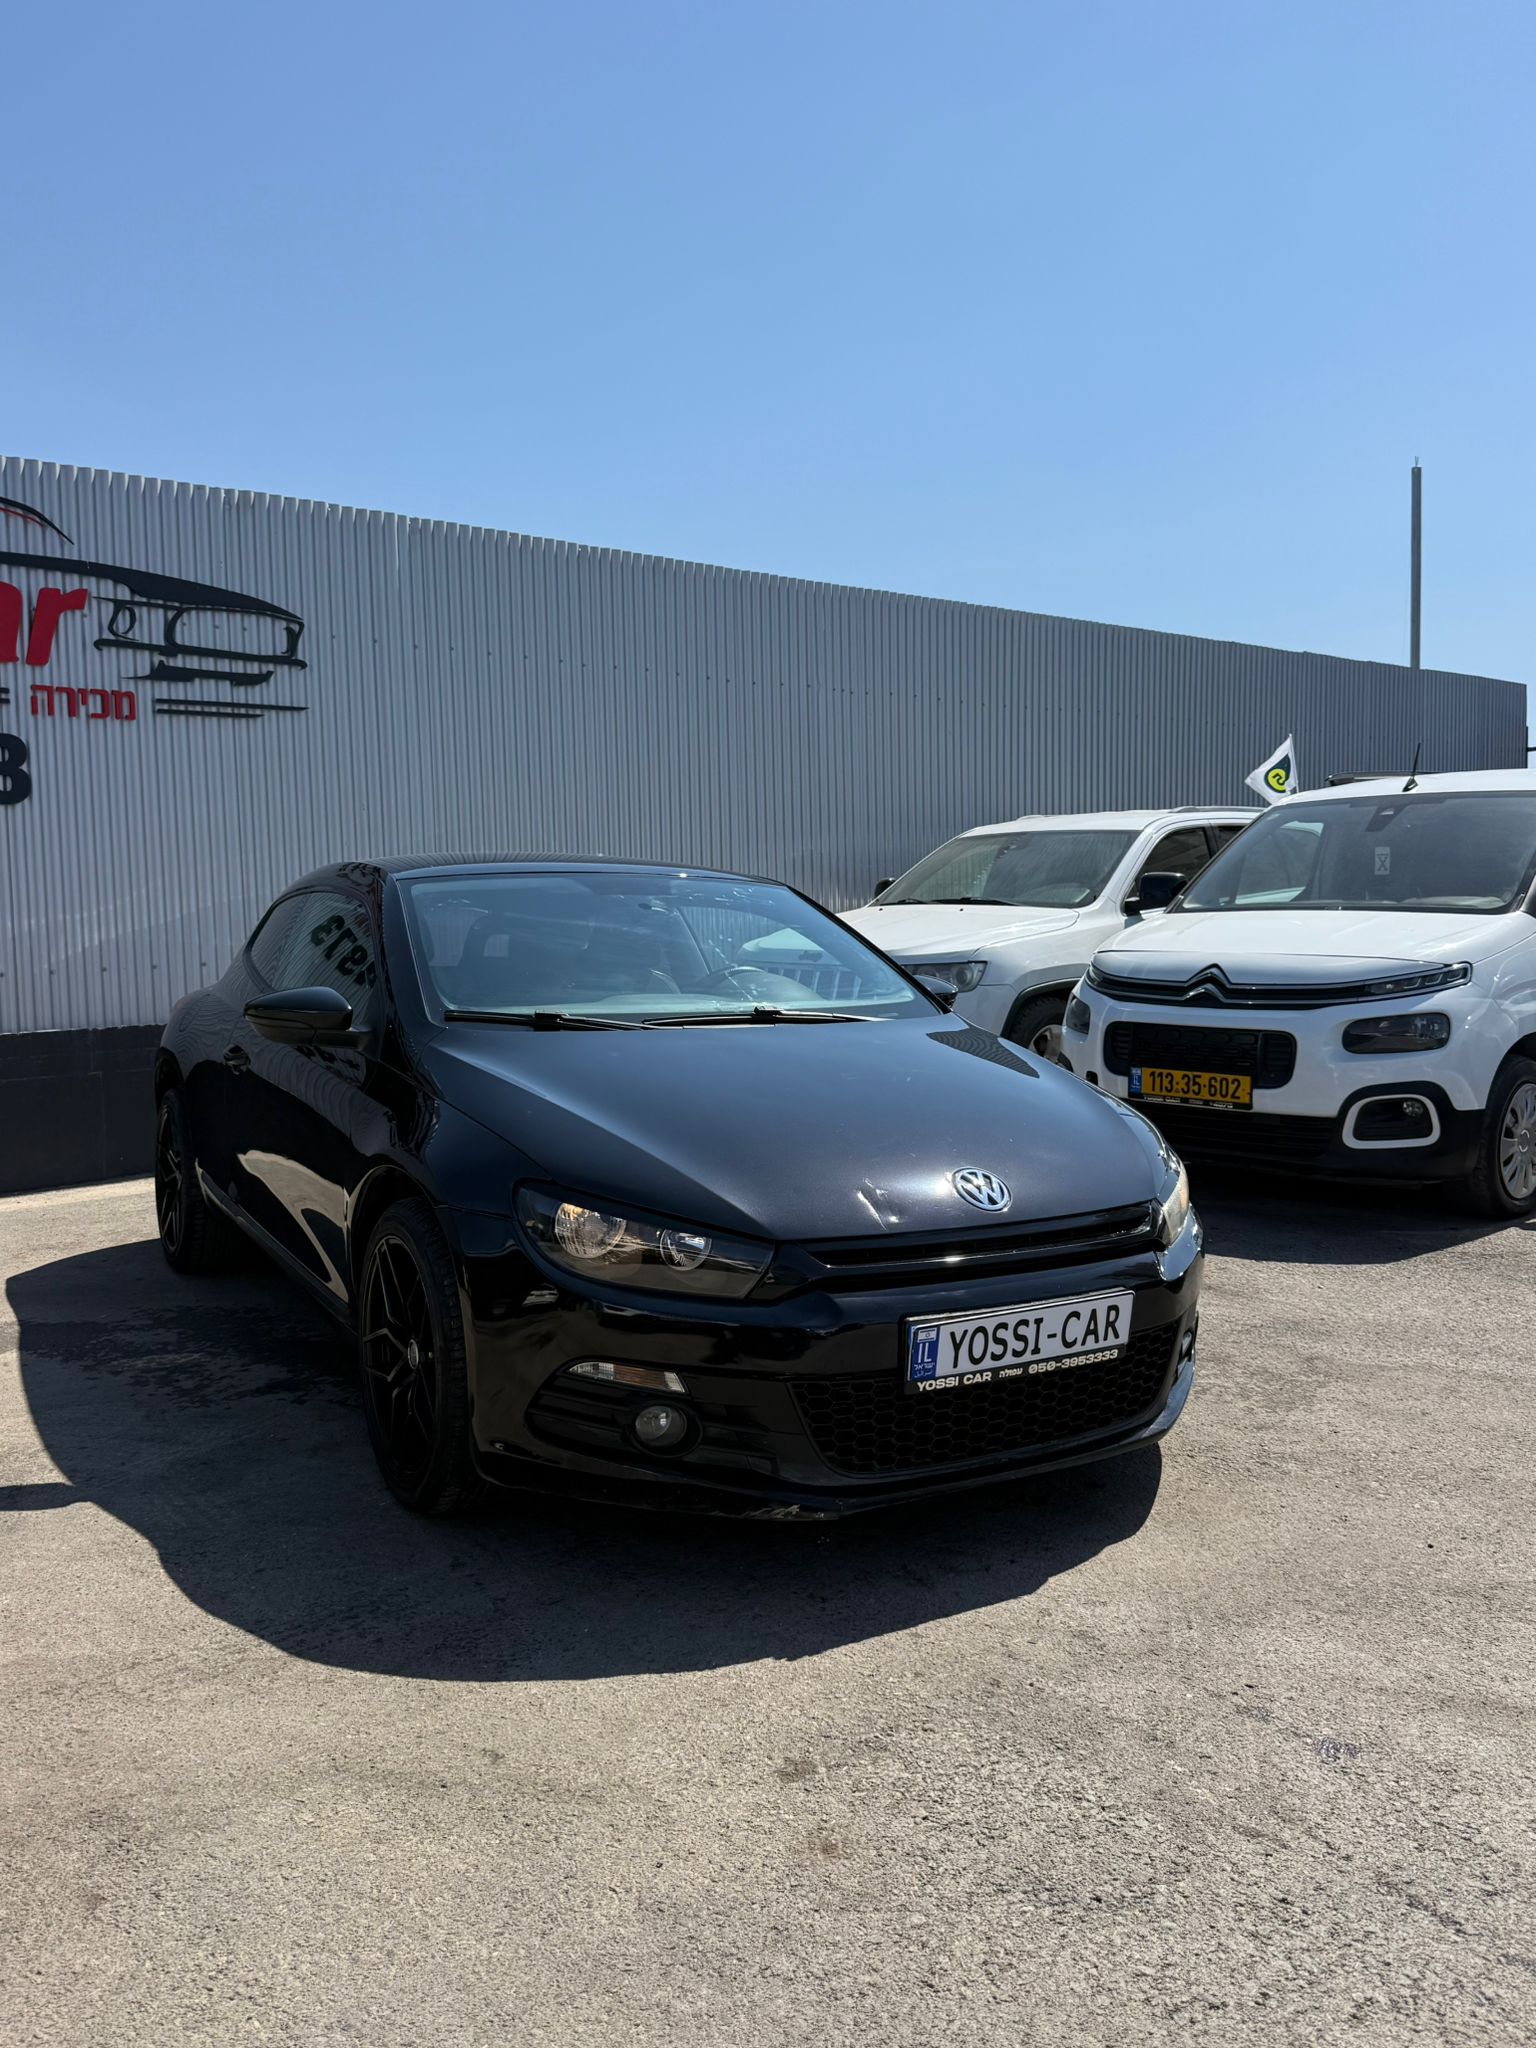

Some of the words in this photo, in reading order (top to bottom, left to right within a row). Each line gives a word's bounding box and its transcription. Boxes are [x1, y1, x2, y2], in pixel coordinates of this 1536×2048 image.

[30, 684, 137, 721] מכירה
[917, 1342, 932, 1364] IL
[950, 1305, 1120, 1369] YOSSI-CAR
[917, 1376, 959, 1392] YOSSI
[963, 1371, 992, 1385] CAR
[1028, 1349, 1119, 1374] 050-3953333
